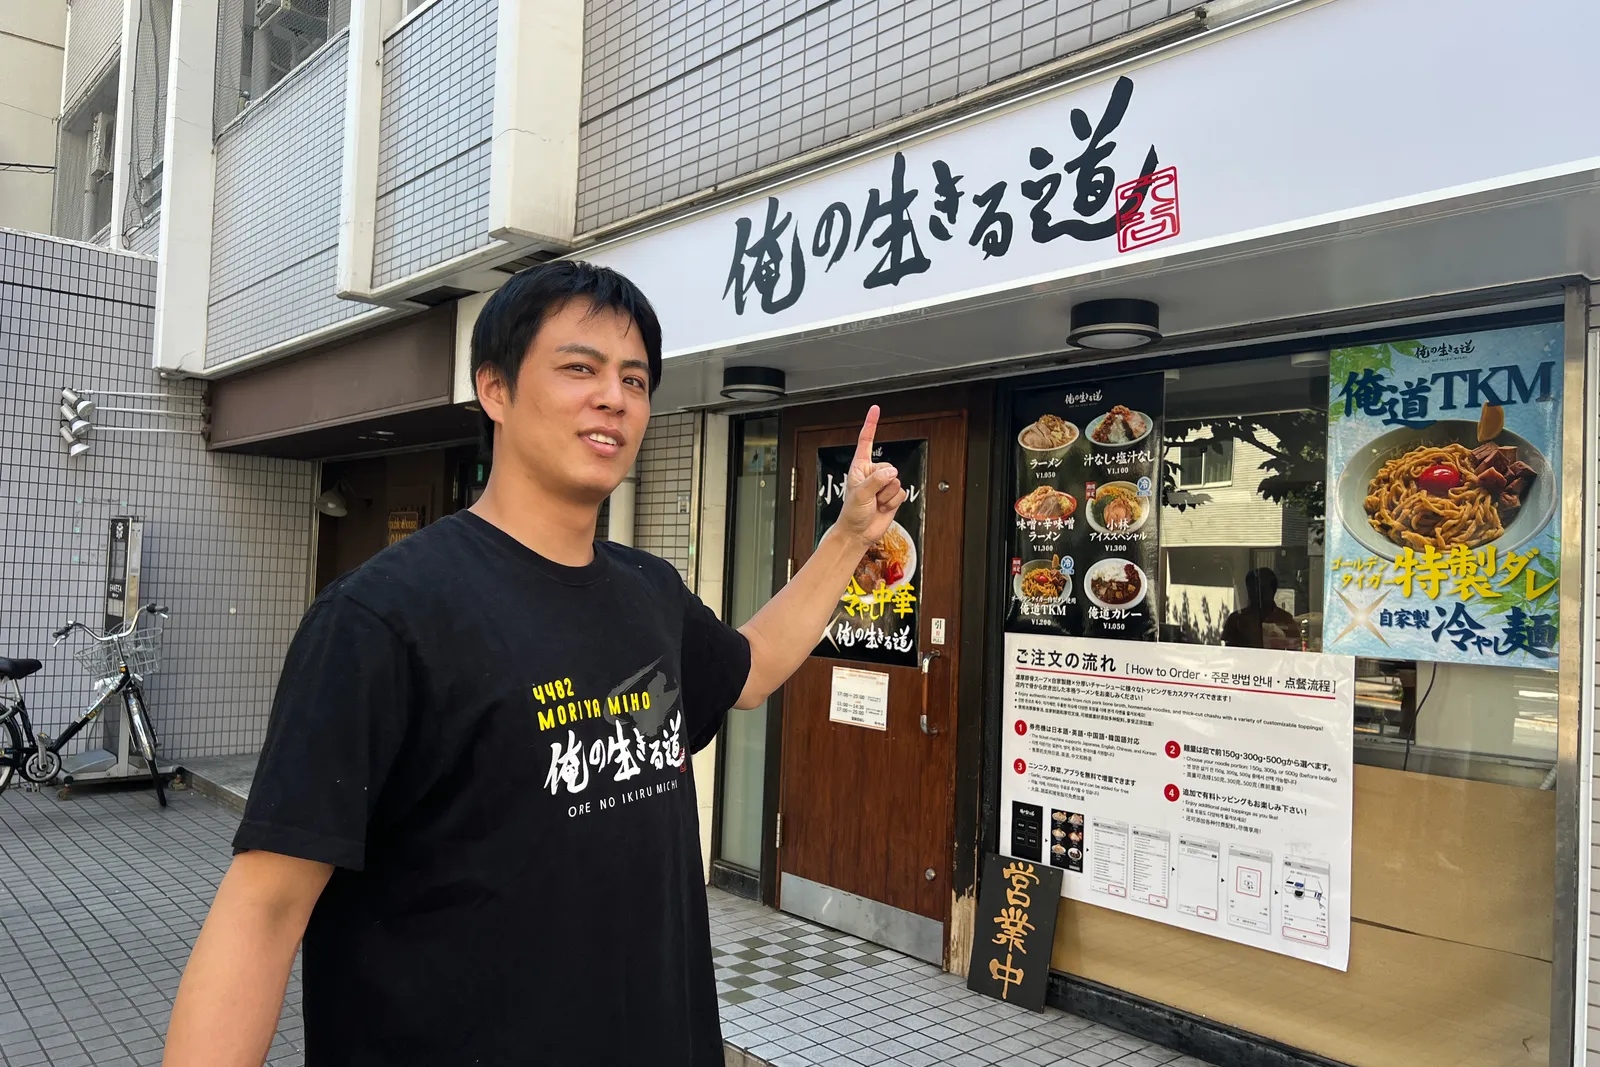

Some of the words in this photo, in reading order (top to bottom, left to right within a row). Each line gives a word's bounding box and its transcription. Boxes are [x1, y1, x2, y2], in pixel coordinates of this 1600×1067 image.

[722, 76, 1159, 316] 俺の生きる道
[1338, 361, 1556, 429] 俺道TKM
[1030, 457, 1063, 469] ラーメン
[1083, 450, 1155, 467] 汁なし・塩汁なし
[1016, 517, 1075, 531] 味噌・辛味噌
[1106, 517, 1129, 531] 小林
[1028, 531, 1061, 542] ラーメン
[1331, 554, 1390, 574] ゴールデン
[1394, 543, 1559, 601] 特製ダレ
[1340, 571, 1396, 590] タイガー
[843, 575, 917, 620] 冷やし中華
[1020, 603, 1066, 616] 俺道TKM
[1088, 606, 1142, 620] 俺道カレー
[1380, 608, 1430, 630] 自家製
[836, 620, 913, 653] 俺の生きる道
[1016, 648, 1117, 673] ご注文の流れ
[1155, 667, 1167, 677] to
[1169, 667, 1201, 680] Order
[1211, 671, 1230, 684] 주문
[1231, 673, 1251, 686] 방법
[1252, 675, 1273, 688] 안내
[533, 677, 575, 704] 4482
[537, 698, 601, 731] MORIYA
[607, 691, 651, 715] MIHO
[543, 710, 685, 795] 俺の生きる道
[1168, 743, 1176, 755] 2
[1016, 761, 1023, 771] 3
[568, 802, 591, 818] ORE
[600, 797, 616, 810] NO
[622, 785, 653, 804] IKIRU
[656, 779, 678, 794] MICHI
[1167, 786, 1175, 798] 4
[989, 861, 1040, 1000] 営業中
